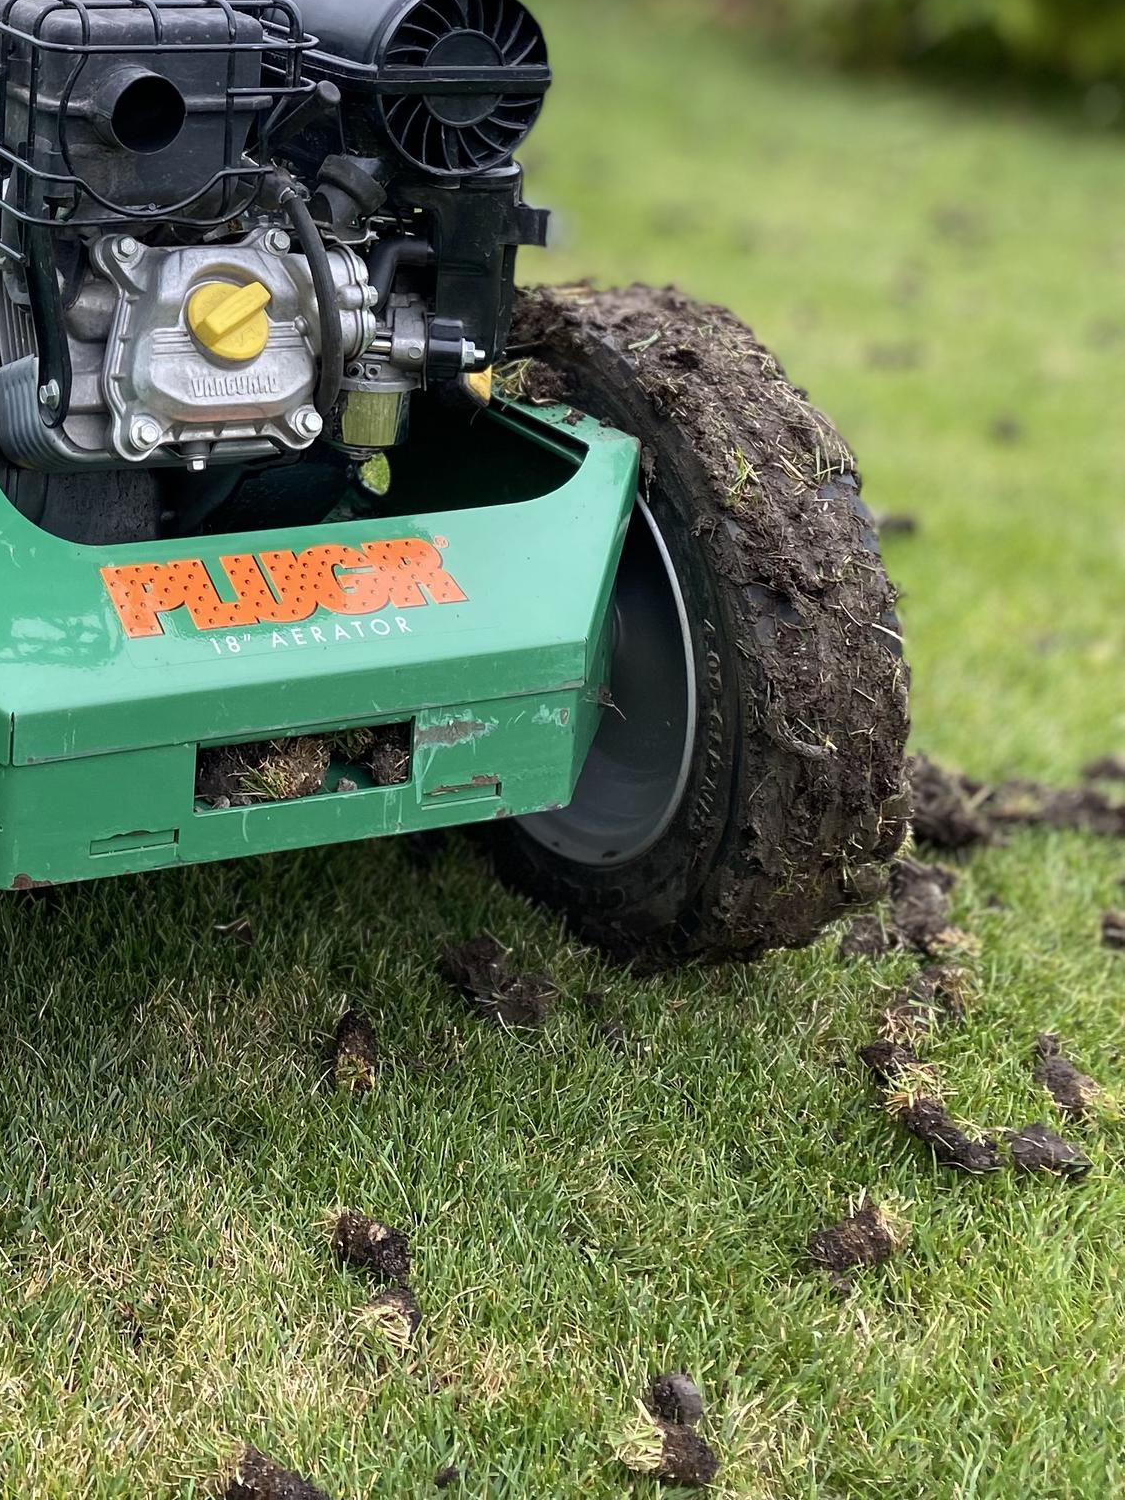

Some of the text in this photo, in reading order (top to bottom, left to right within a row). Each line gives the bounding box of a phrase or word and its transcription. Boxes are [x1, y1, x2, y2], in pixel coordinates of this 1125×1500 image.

[191, 374, 280, 397] VANGUARD
[100, 537, 469, 639] PLUGR
[209, 616, 413, 655] 18" AERATOR
